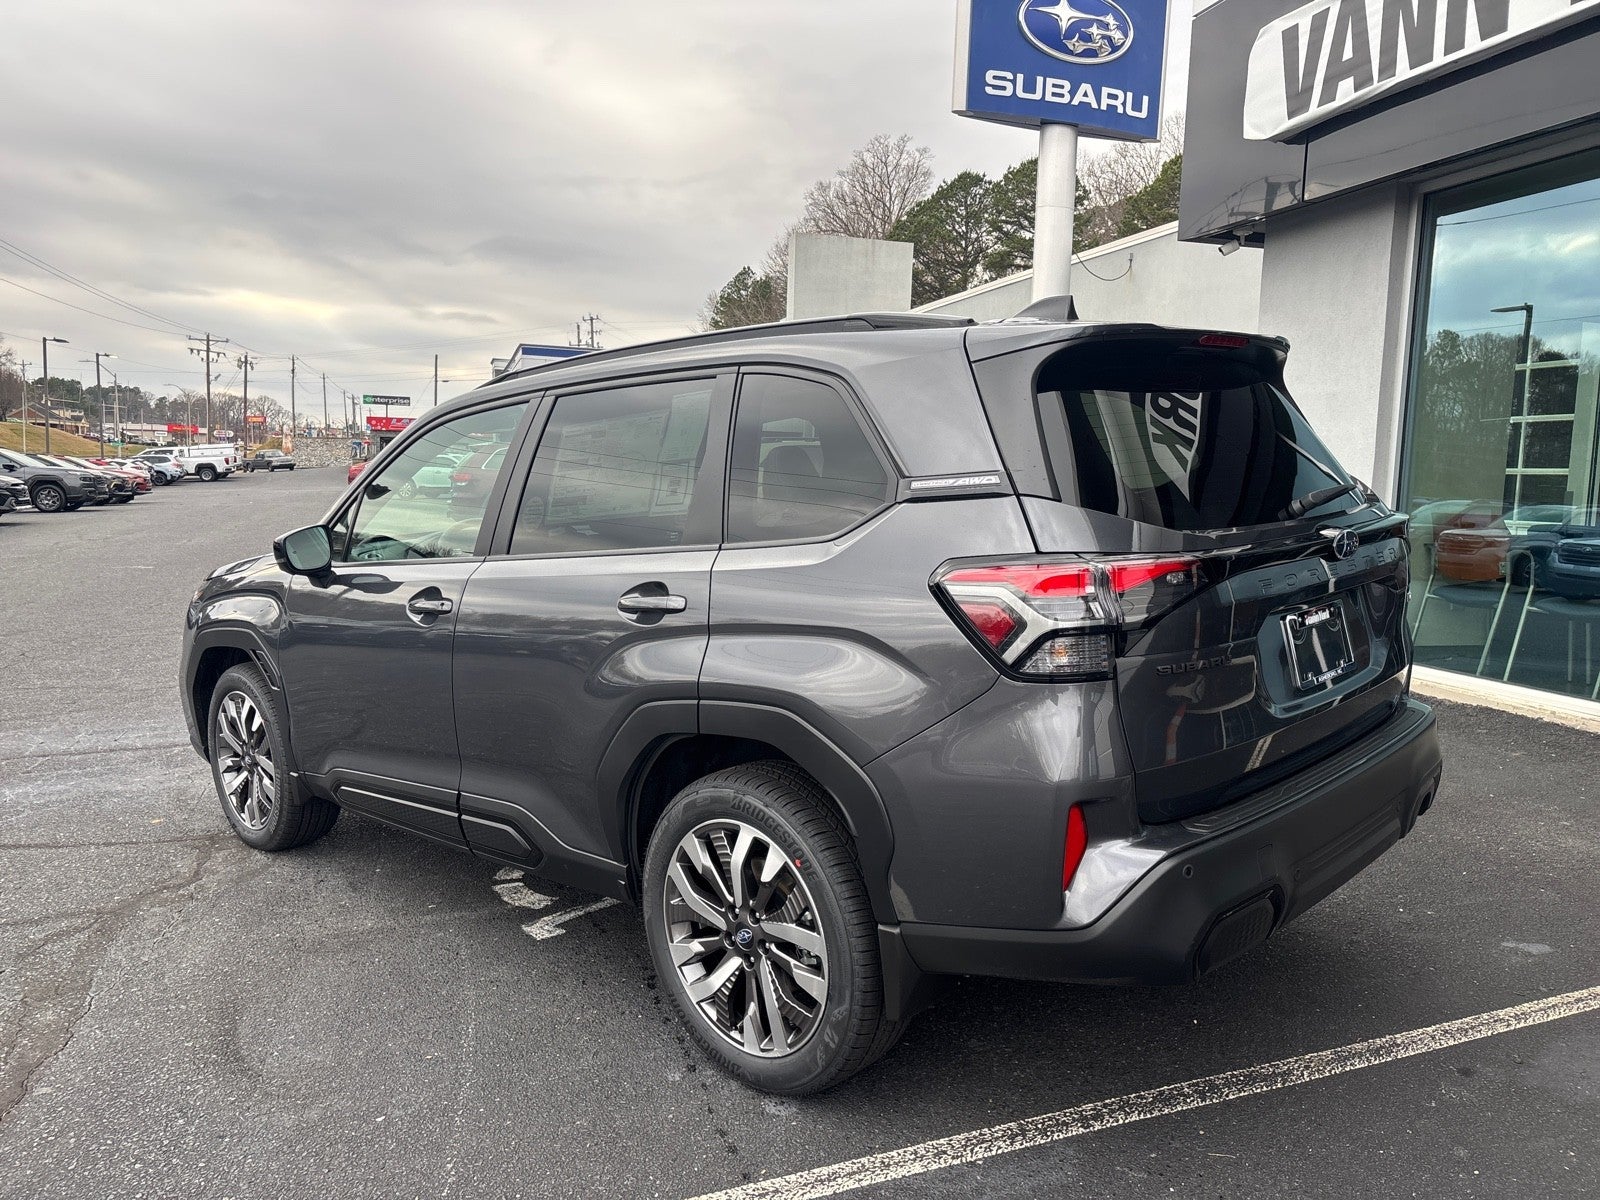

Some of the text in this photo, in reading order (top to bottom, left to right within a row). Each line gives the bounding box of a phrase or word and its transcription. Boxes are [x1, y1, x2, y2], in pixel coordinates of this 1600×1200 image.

[984, 69, 1149, 119] SUBARU
[366, 396, 410, 404] enterprise
[1257, 547, 1397, 596] FORESTER
[1156, 656, 1233, 676] SUBARU
[730, 797, 819, 881] BRIDGESTONE
